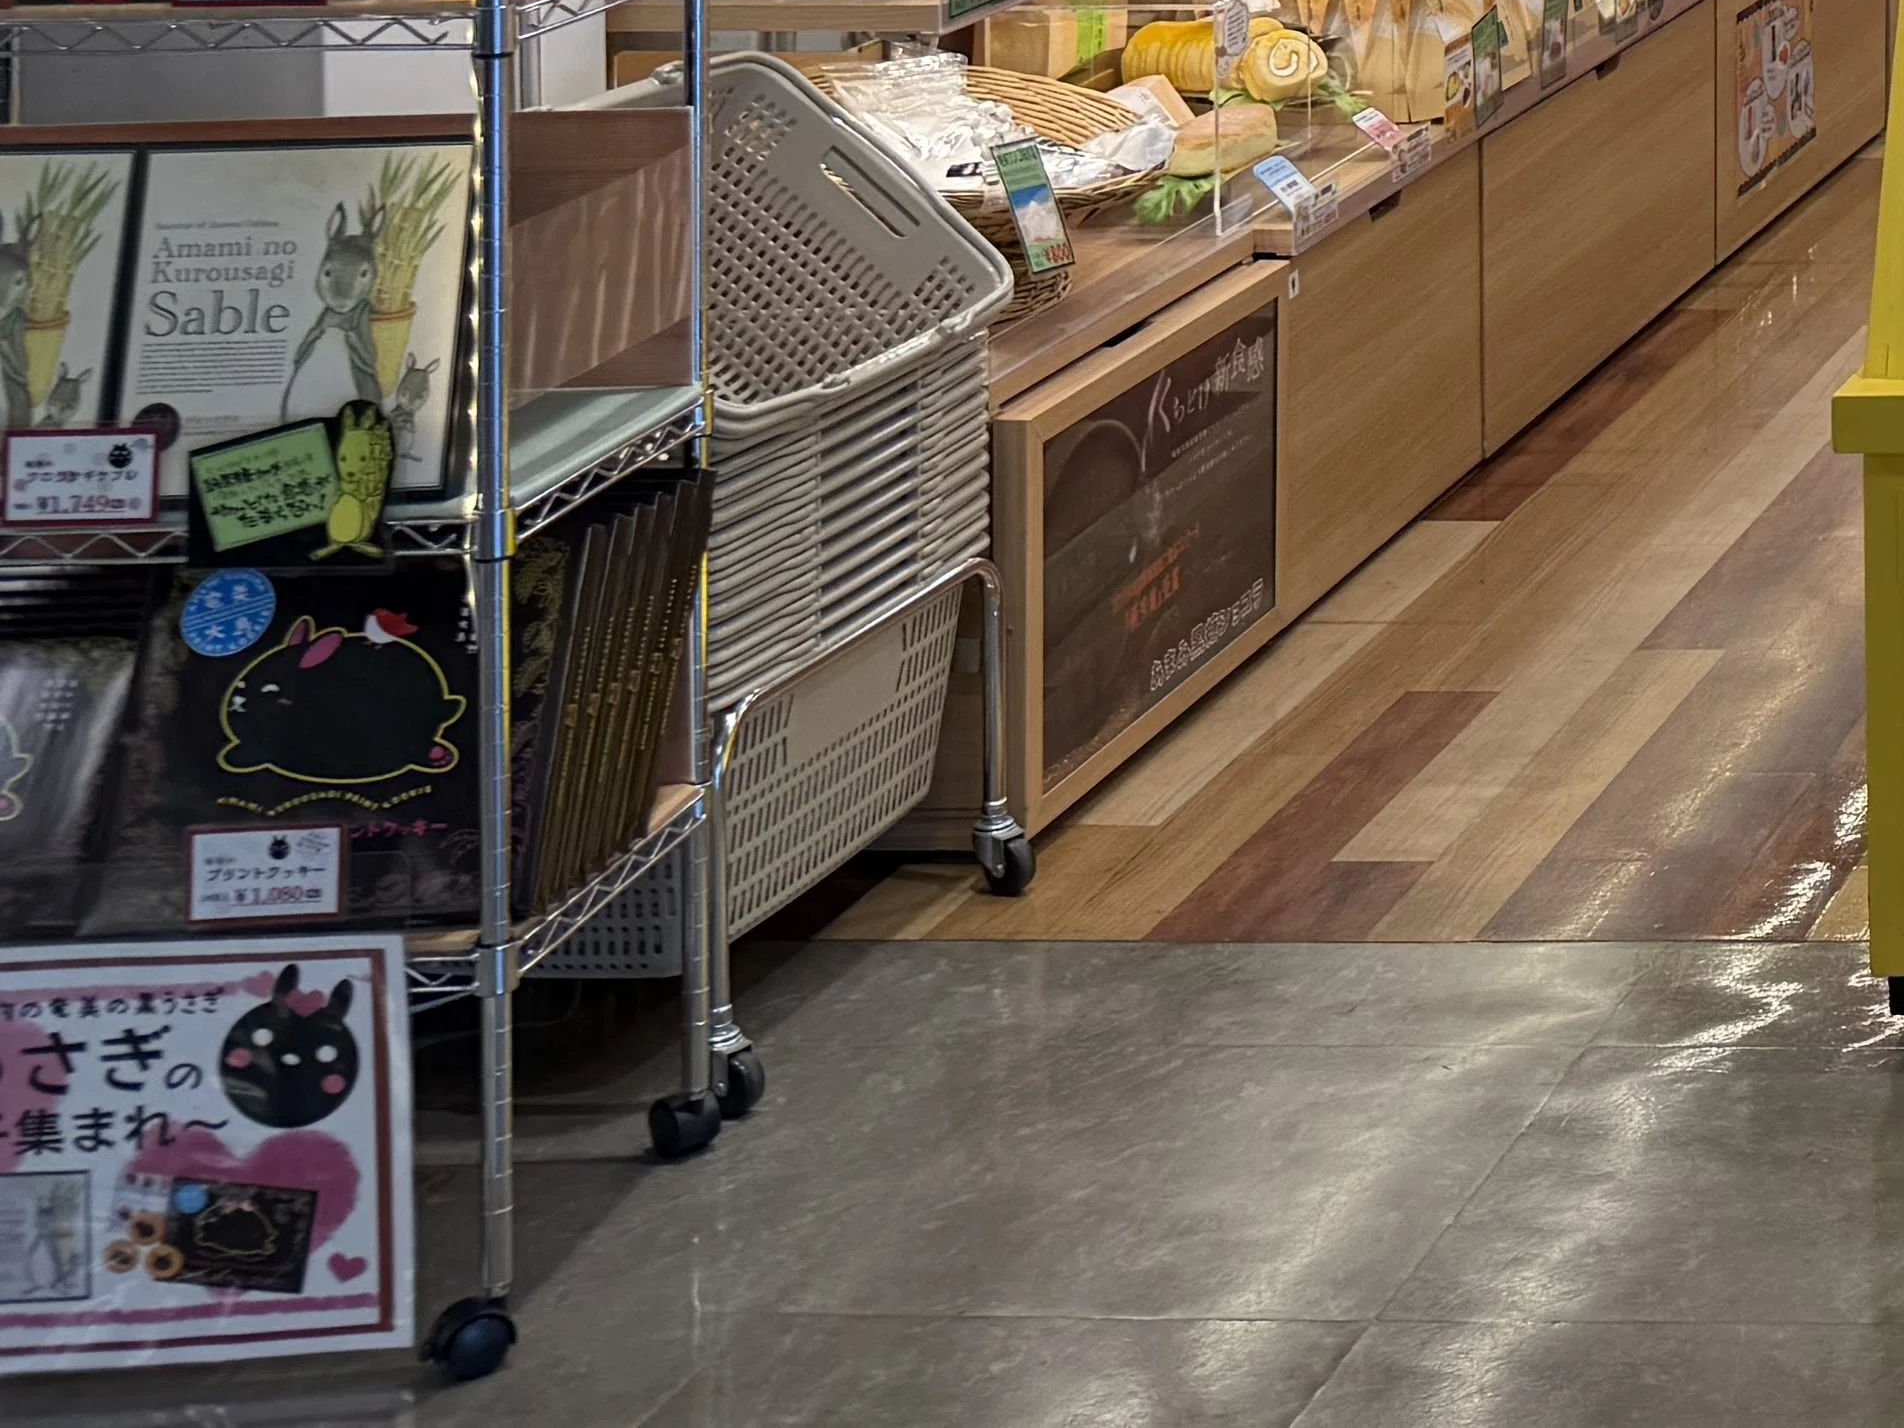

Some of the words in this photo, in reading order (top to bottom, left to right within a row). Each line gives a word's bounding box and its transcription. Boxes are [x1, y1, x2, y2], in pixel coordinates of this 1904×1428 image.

[153, 237, 253, 259] Amami
[265, 242, 297, 256] no
[151, 260, 295, 286] Kurousagi
[144, 290, 291, 338] Sable
